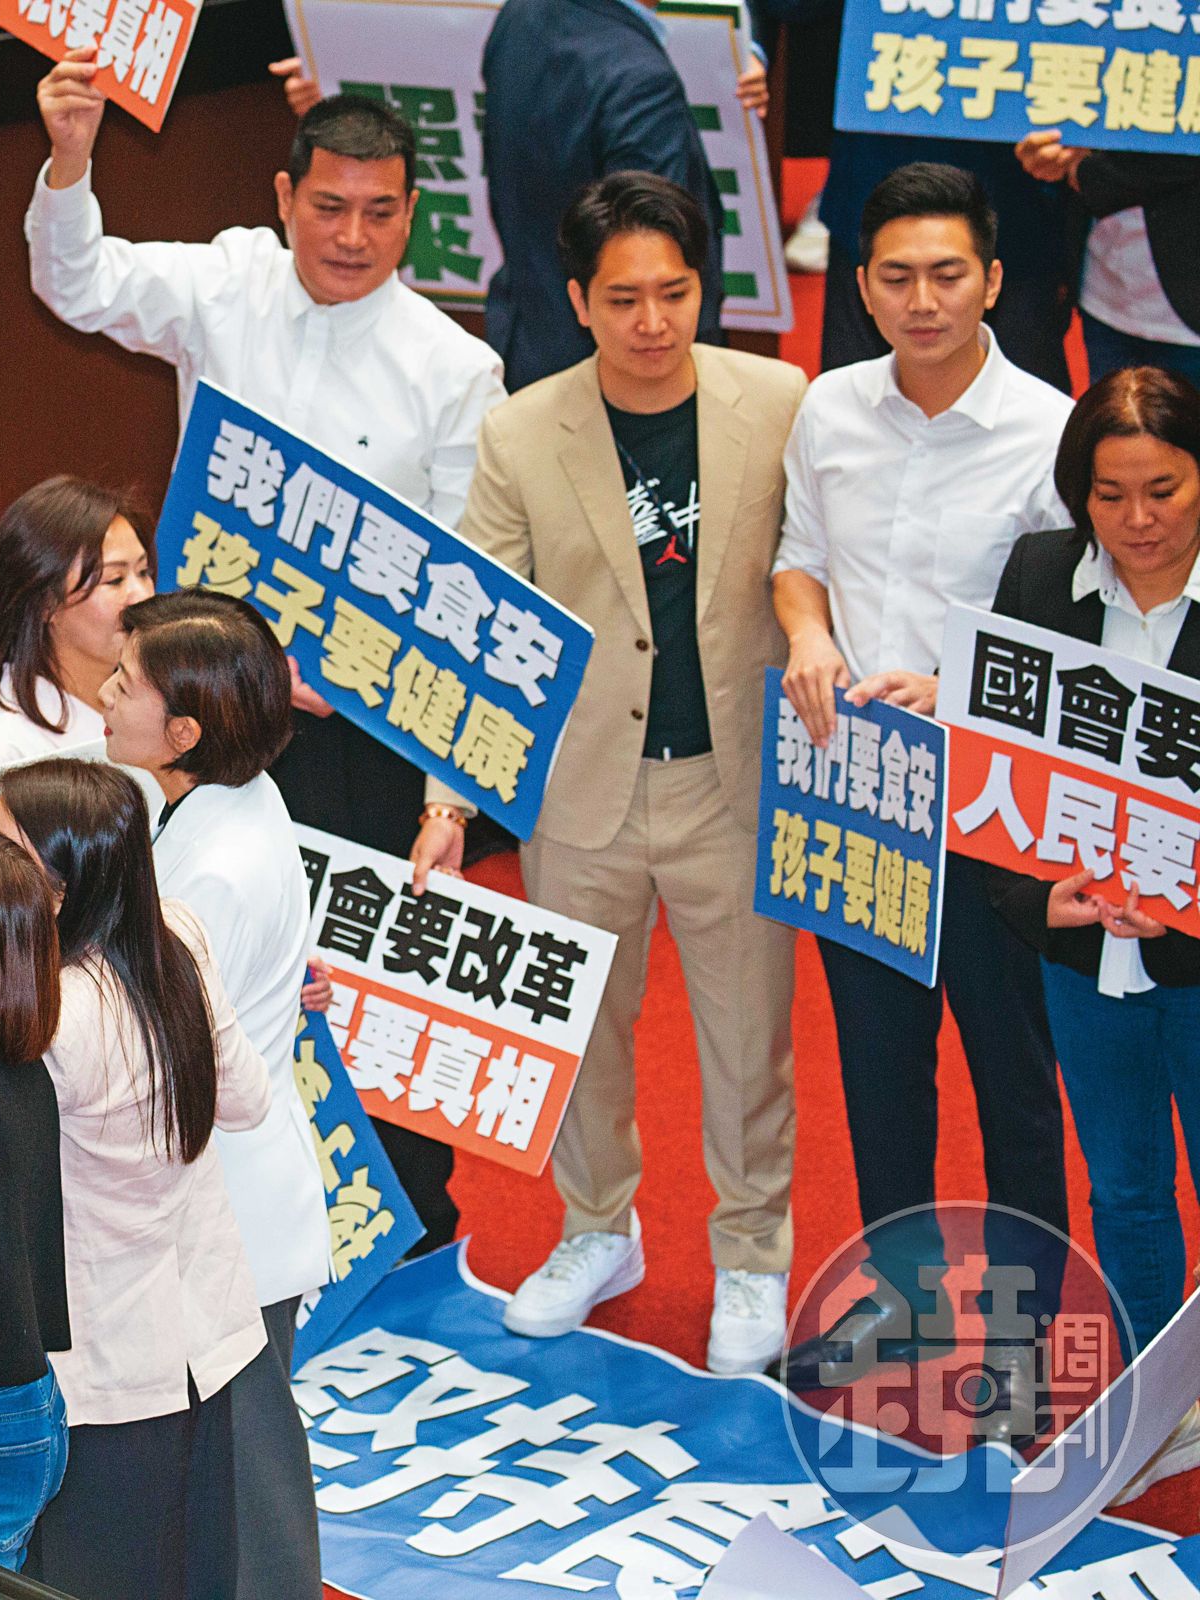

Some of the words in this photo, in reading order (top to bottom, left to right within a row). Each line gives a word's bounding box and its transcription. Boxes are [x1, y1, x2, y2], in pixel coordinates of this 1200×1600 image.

[865, 32, 1200, 134] 孩子要健
[206, 418, 564, 707] 我們要食安
[176, 511, 536, 804] 孩子要健康
[769, 808, 933, 957] 孩子要健康
[952, 751, 1200, 911] 人民要
[326, 982, 556, 1153] 要真相
